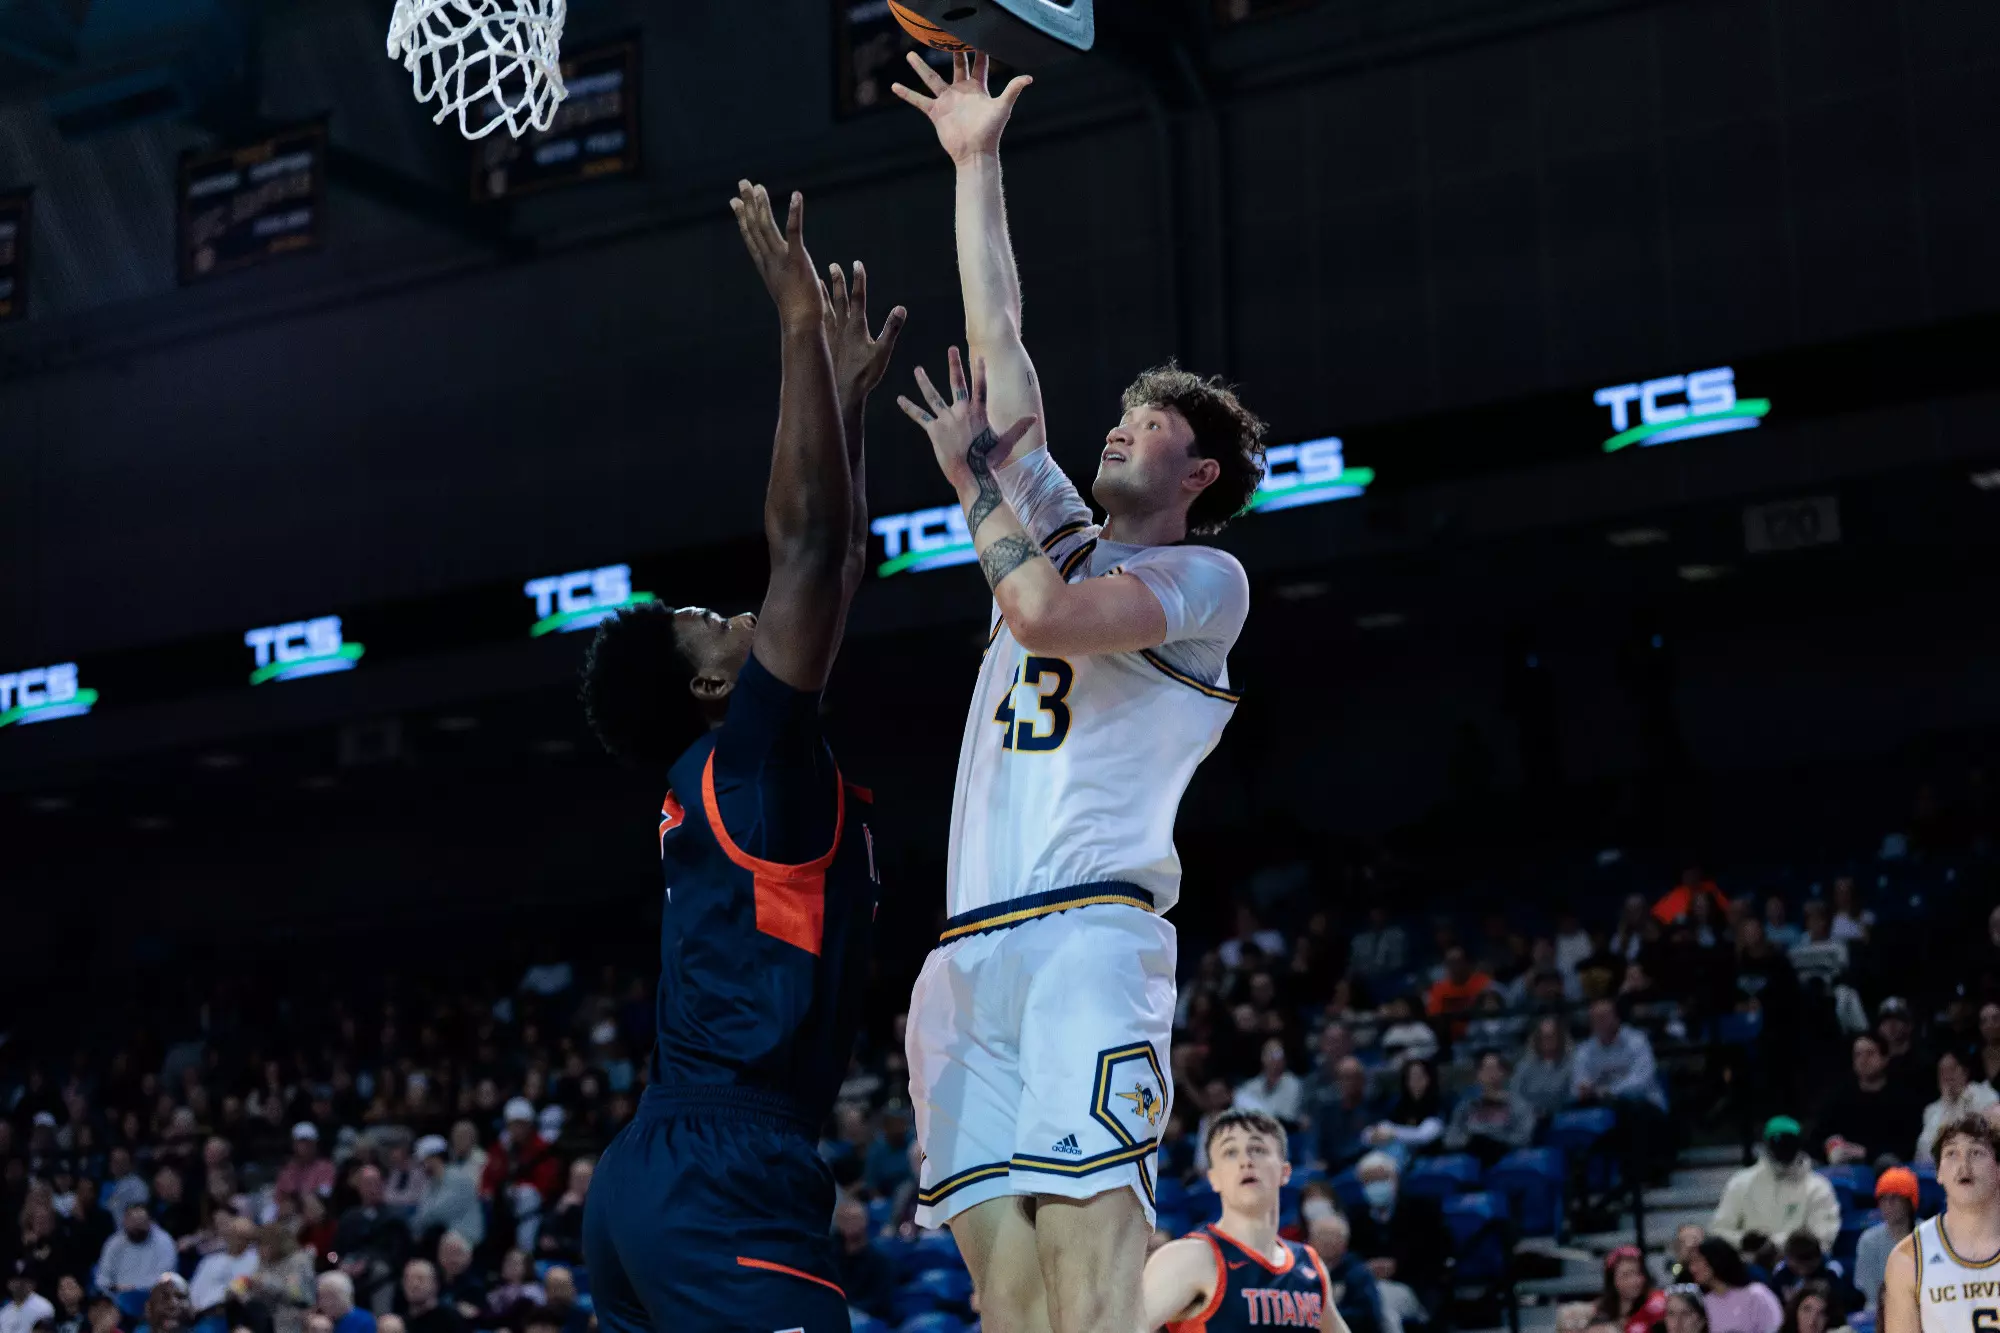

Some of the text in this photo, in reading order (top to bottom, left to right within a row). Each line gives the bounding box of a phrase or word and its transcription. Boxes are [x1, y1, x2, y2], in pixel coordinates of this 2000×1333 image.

[1593, 366, 1737, 432] TCS
[1256, 436, 1344, 492] CS
[524, 562, 632, 620] TCS
[244, 614, 343, 668] TCS
[992, 654, 1075, 754] 43
[1051, 1145, 1083, 1156] adidas
[1929, 1285, 1956, 1303] UC
